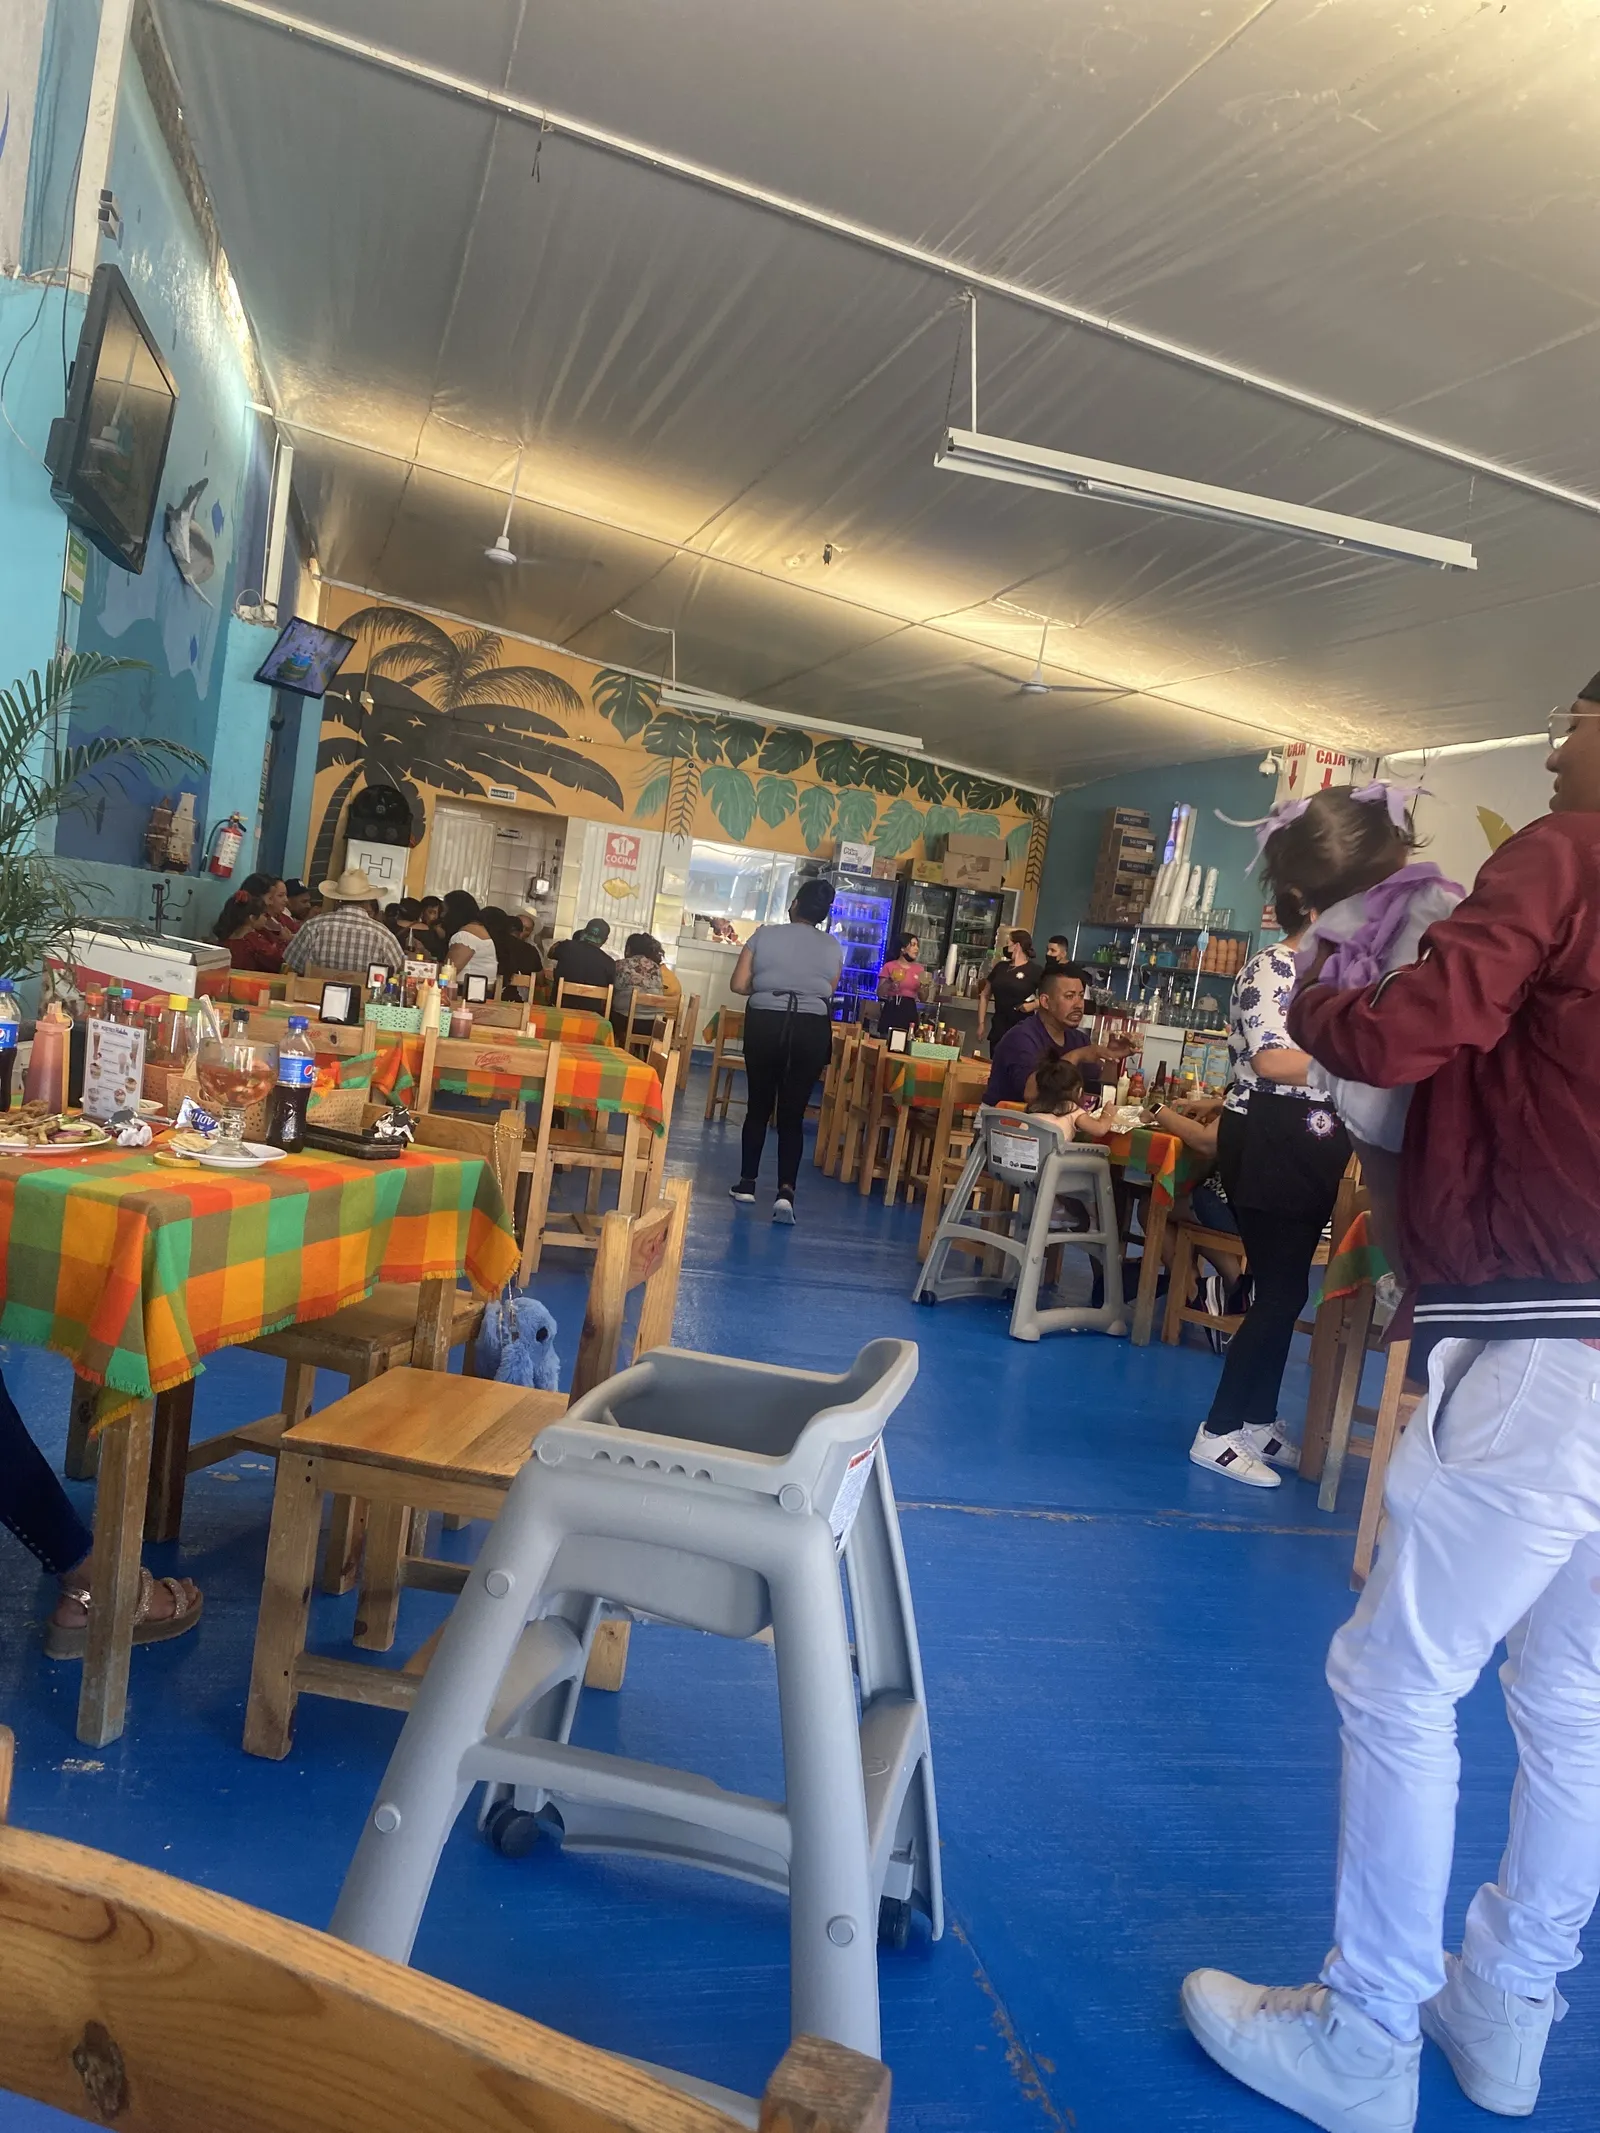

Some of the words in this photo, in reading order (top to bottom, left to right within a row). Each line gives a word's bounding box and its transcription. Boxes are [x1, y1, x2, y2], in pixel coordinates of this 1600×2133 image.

[1287, 742, 1307, 758] CAJA
[1316, 750, 1346, 766] CAJA
[605, 854, 638, 867] COCINA
